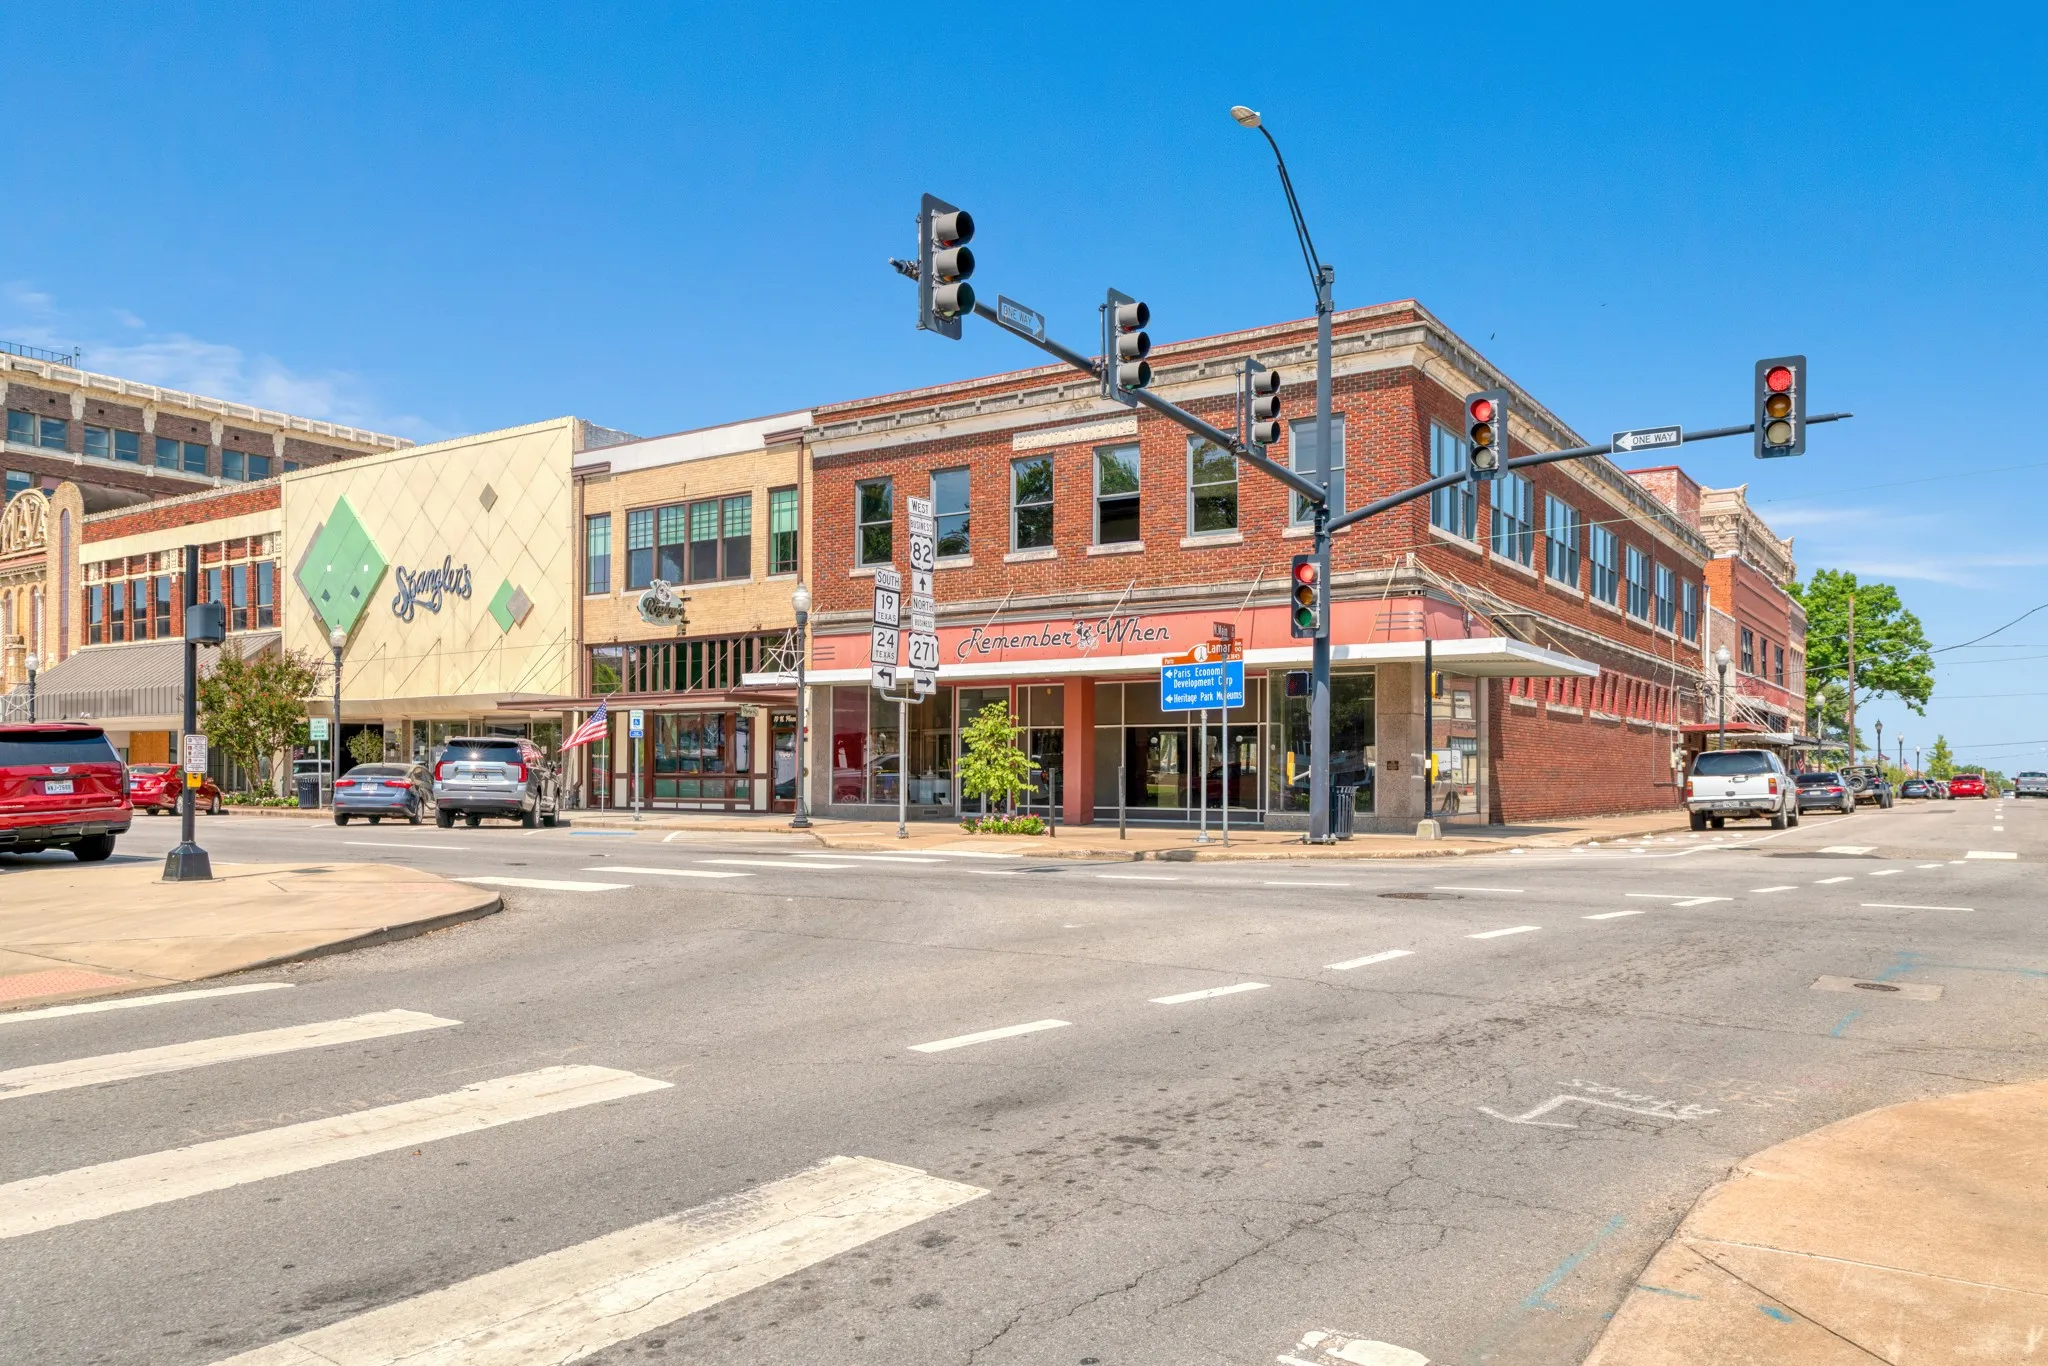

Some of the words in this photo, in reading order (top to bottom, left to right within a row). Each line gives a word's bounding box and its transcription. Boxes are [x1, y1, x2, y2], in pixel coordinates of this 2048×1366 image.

[1004, 305, 1018, 319] ONE
[1019, 312, 1032, 327] WAY
[1633, 435, 1651, 445] ONE
[1654, 432, 1674, 441] WAY
[912, 500, 929, 514] WEST
[910, 519, 933, 533] BUSINESS
[913, 542, 932, 564] 82
[878, 571, 899, 586] SOUTH
[392, 554, 472, 624] Spangler's
[881, 594, 893, 610] 19
[913, 597, 933, 612] NORTH
[877, 612, 896, 622] TEXAS
[914, 618, 933, 629] BUSINESS
[877, 631, 894, 648] 24
[957, 623, 1073, 659] Remember
[1096, 618, 1170, 643] When
[875, 650, 894, 660] TEXAS
[913, 640, 935, 662] 271
[1207, 643, 1231, 654] Lamar
[1173, 668, 1191, 678] Paris
[1195, 665, 1223, 677] Economi
[1173, 677, 1214, 689] Development
[1218, 676, 1233, 687] Crp
[1173, 693, 1197, 705] Heritage
[1200, 691, 1214, 702] Park
[1216, 690, 1242, 701] Mueums
